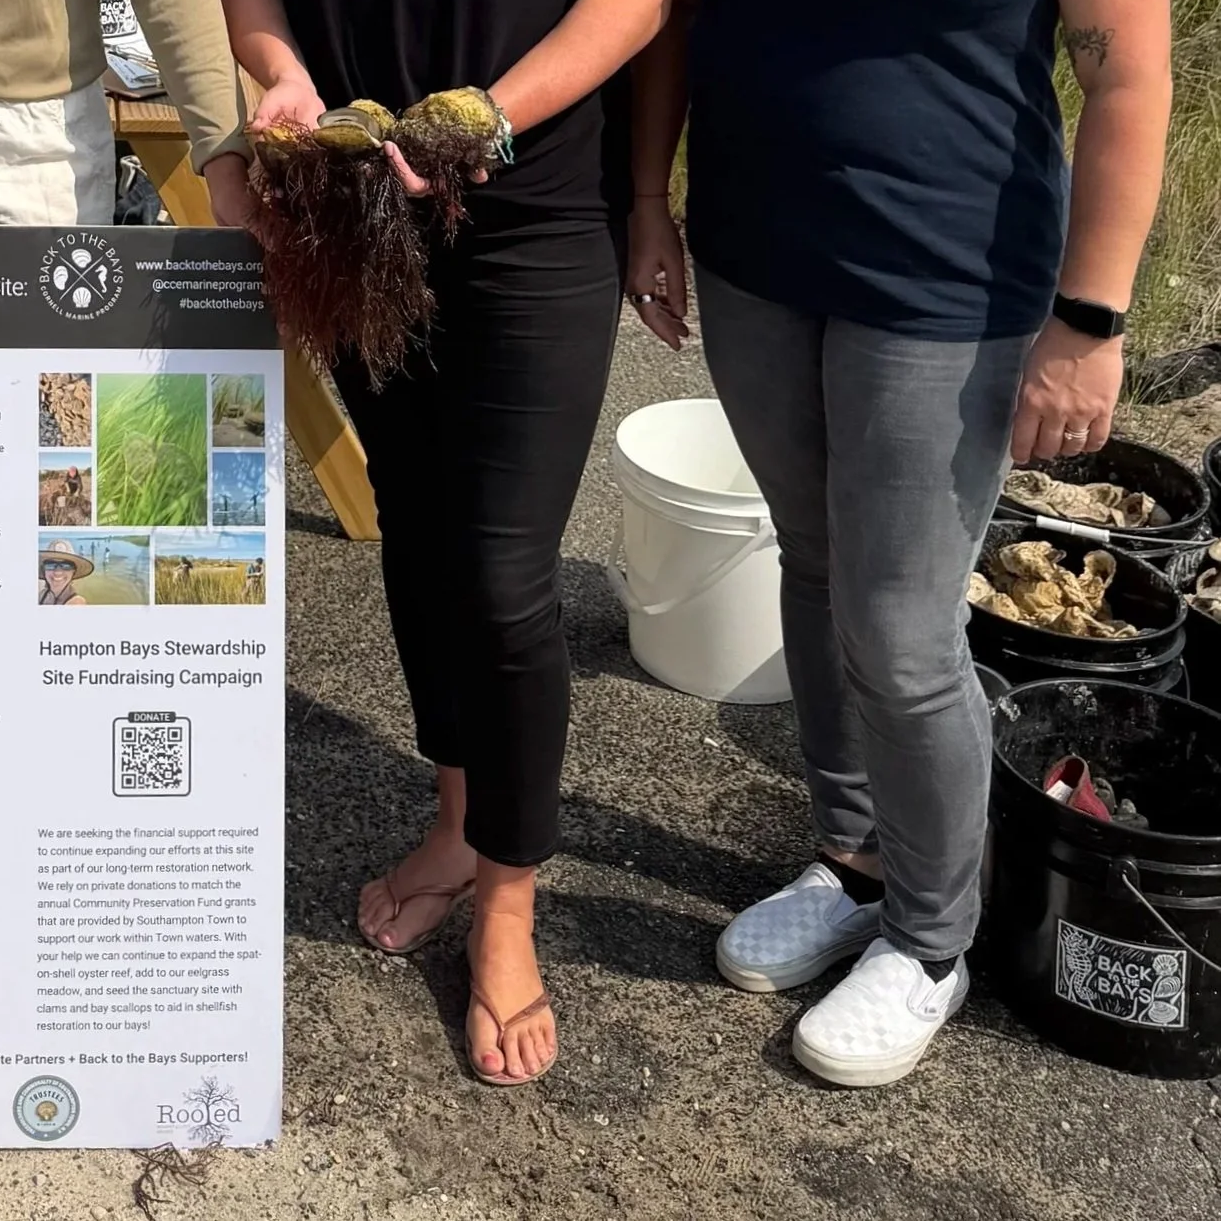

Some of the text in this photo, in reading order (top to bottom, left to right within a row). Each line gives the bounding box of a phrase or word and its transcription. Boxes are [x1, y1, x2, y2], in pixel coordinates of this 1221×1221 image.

[39, 233, 124, 284] BACK TO THE BAYS
[135, 258, 264, 273] www.backtothebays.org
[40, 285, 122, 320] CORNELL MARINE PROGRAM
[179, 297, 264, 311] #backtothebays
[39, 639, 266, 659] Hampton Bays Stewardship
[42, 668, 262, 688] Site Fundraising Campaign
[134, 713, 170, 721] DONATE
[37, 827, 258, 840] We are seeking the financial support required
[37, 897, 256, 910] annual Community Preservation Fund grants
[1098, 955, 1152, 982] BACK
[1108, 973, 1140, 987] TO THE
[1098, 977, 1152, 1004] BAYS
[14, 1053, 65, 1064] Partners
[78, 1053, 108, 1064] Back
[110, 1054, 123, 1063] to
[126, 1052, 145, 1063] the
[148, 1052, 176, 1065] Bays
[179, 1051, 248, 1065] Supporters!
[29, 1090, 64, 1103] TRUSTEES
